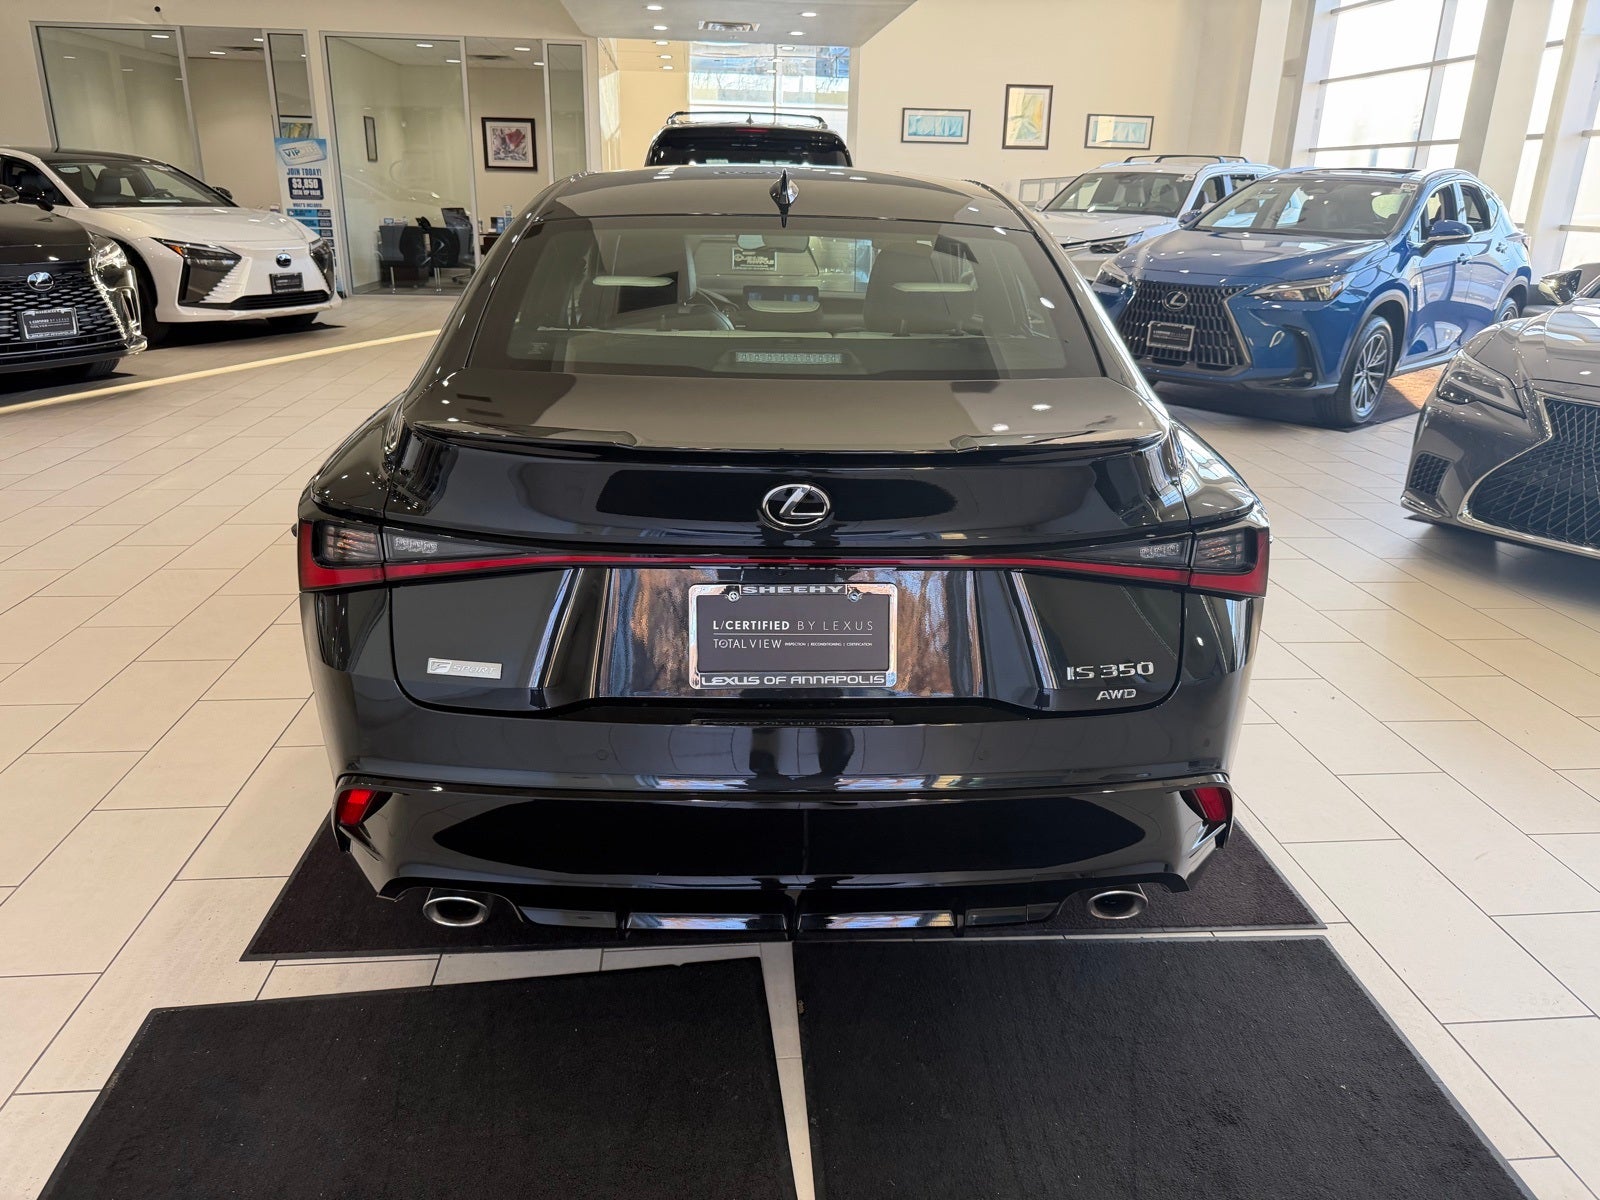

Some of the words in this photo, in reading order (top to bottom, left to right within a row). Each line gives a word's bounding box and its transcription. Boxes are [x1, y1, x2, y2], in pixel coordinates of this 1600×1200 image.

[287, 167, 301, 176] JOIN
[302, 167, 322, 176] TODAY!
[742, 586, 844, 594] SHEEHY
[712, 620, 790, 631] L/CERTIFIED
[797, 620, 816, 631] BY
[823, 620, 873, 632] LEXUS
[713, 638, 747, 649] TOTAL
[749, 638, 782, 649] VIEW
[452, 664, 497, 675] SPORT
[1066, 665, 1095, 681] IS
[1099, 661, 1155, 679] 350
[701, 676, 760, 686] LEXUS
[763, 676, 787, 685] OF
[790, 674, 885, 685] ANNAPOLIS
[1095, 688, 1137, 701] AWD
